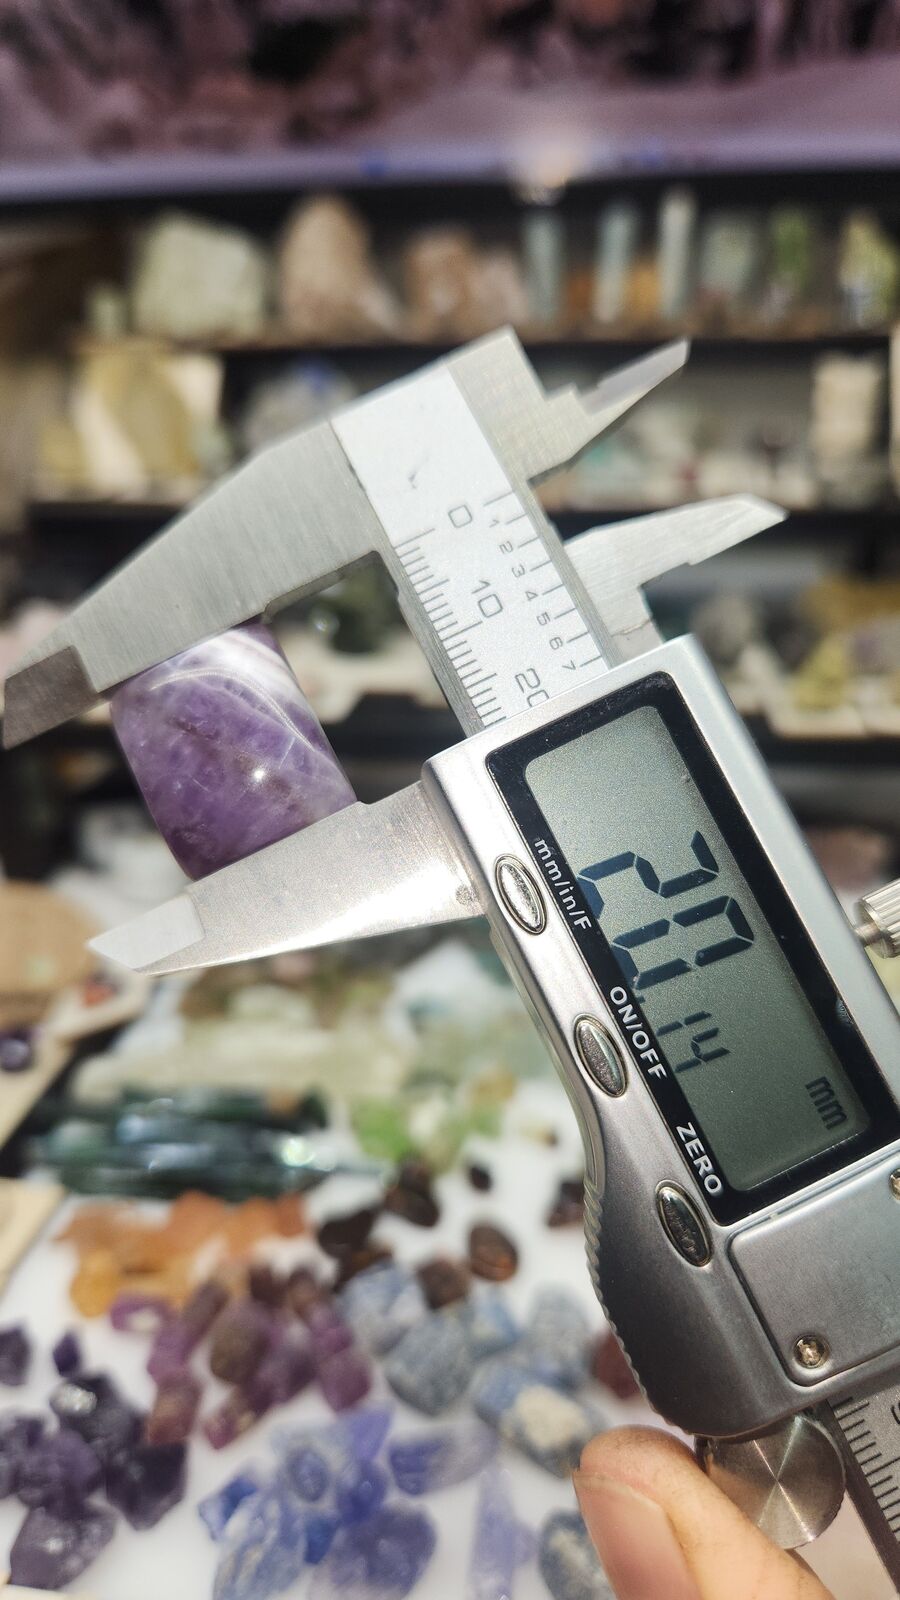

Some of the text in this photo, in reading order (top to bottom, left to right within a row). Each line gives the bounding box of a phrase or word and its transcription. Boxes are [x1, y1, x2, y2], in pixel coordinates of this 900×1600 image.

[447, 504, 550, 708] 0 10 20
[489, 518, 577, 671] 1 2 3 4 5 6 7
[534, 838, 592, 931] mm/in/F
[609, 986, 668, 1080] ON/OFF
[804, 1076, 848, 1130] mm
[676, 1121, 724, 1195] ZERO
